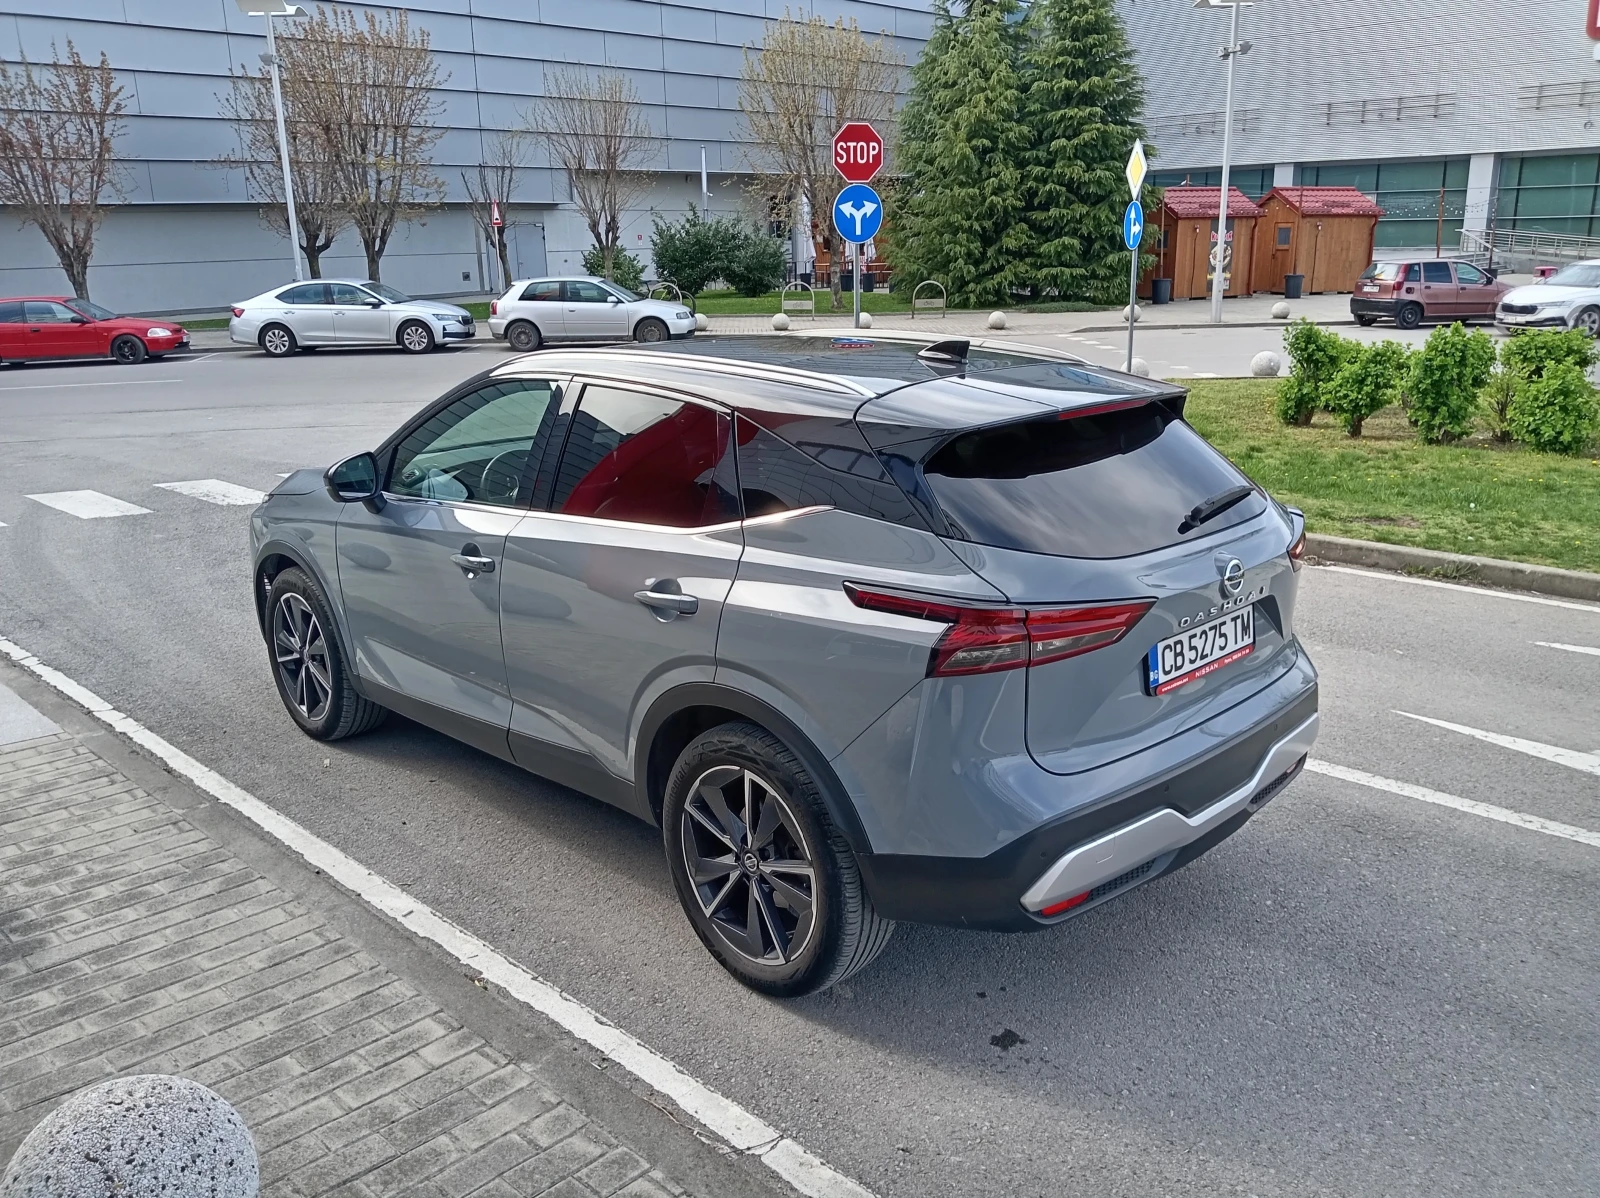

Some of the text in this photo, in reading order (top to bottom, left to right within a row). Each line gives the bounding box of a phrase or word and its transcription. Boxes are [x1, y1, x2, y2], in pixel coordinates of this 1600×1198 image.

[836, 141, 879, 164] STOP
[1161, 639, 1185, 676] CB
[1188, 620, 1228, 665] 5275
[1231, 610, 1251, 645] TM
[1150, 669, 1159, 681] BG
[1195, 663, 1219, 678] NISSAN
[664, 767, 688, 832] Cinental
